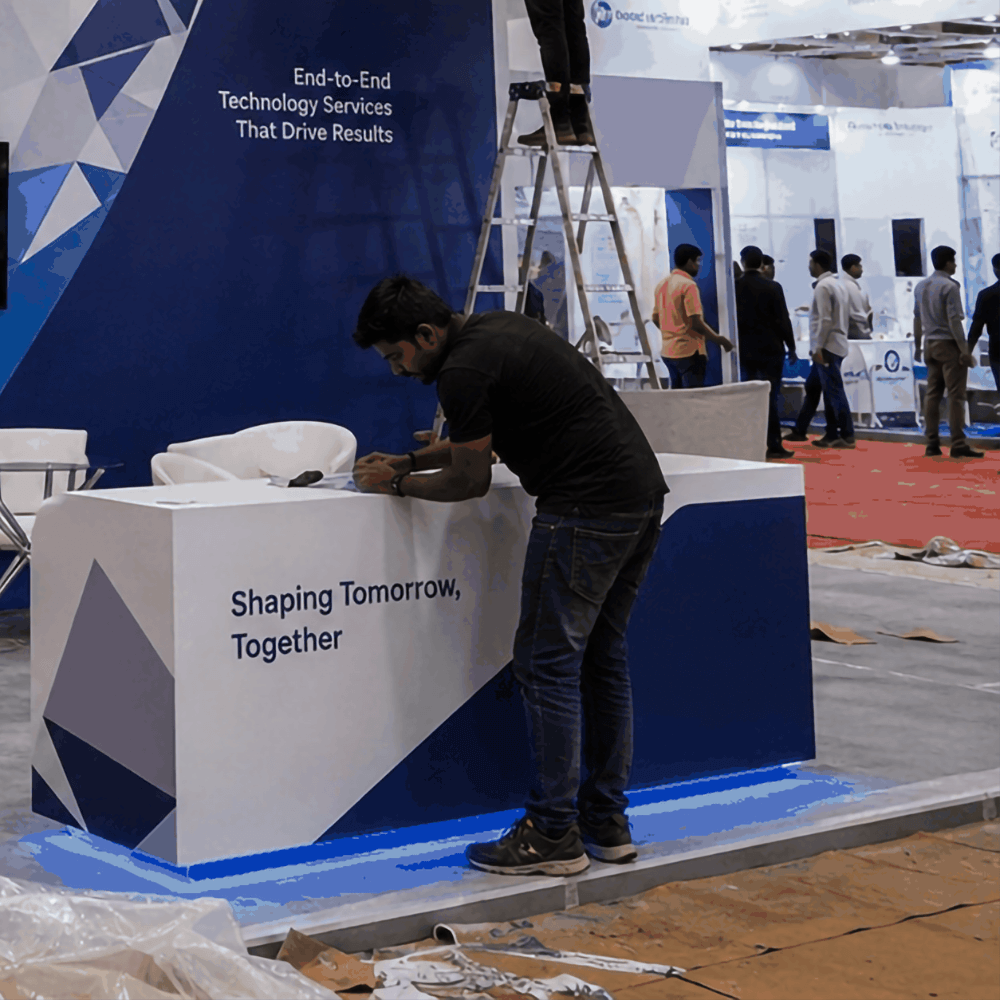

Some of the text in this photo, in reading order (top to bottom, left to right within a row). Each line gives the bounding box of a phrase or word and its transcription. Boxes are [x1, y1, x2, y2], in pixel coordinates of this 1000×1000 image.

[293, 67, 391, 90] End-to-End
[217, 90, 393, 118] Technology Services
[235, 119, 394, 144] That Drive Results
[231, 577, 461, 620] Shaping Tomorrow,
[230, 626, 343, 664] Together
